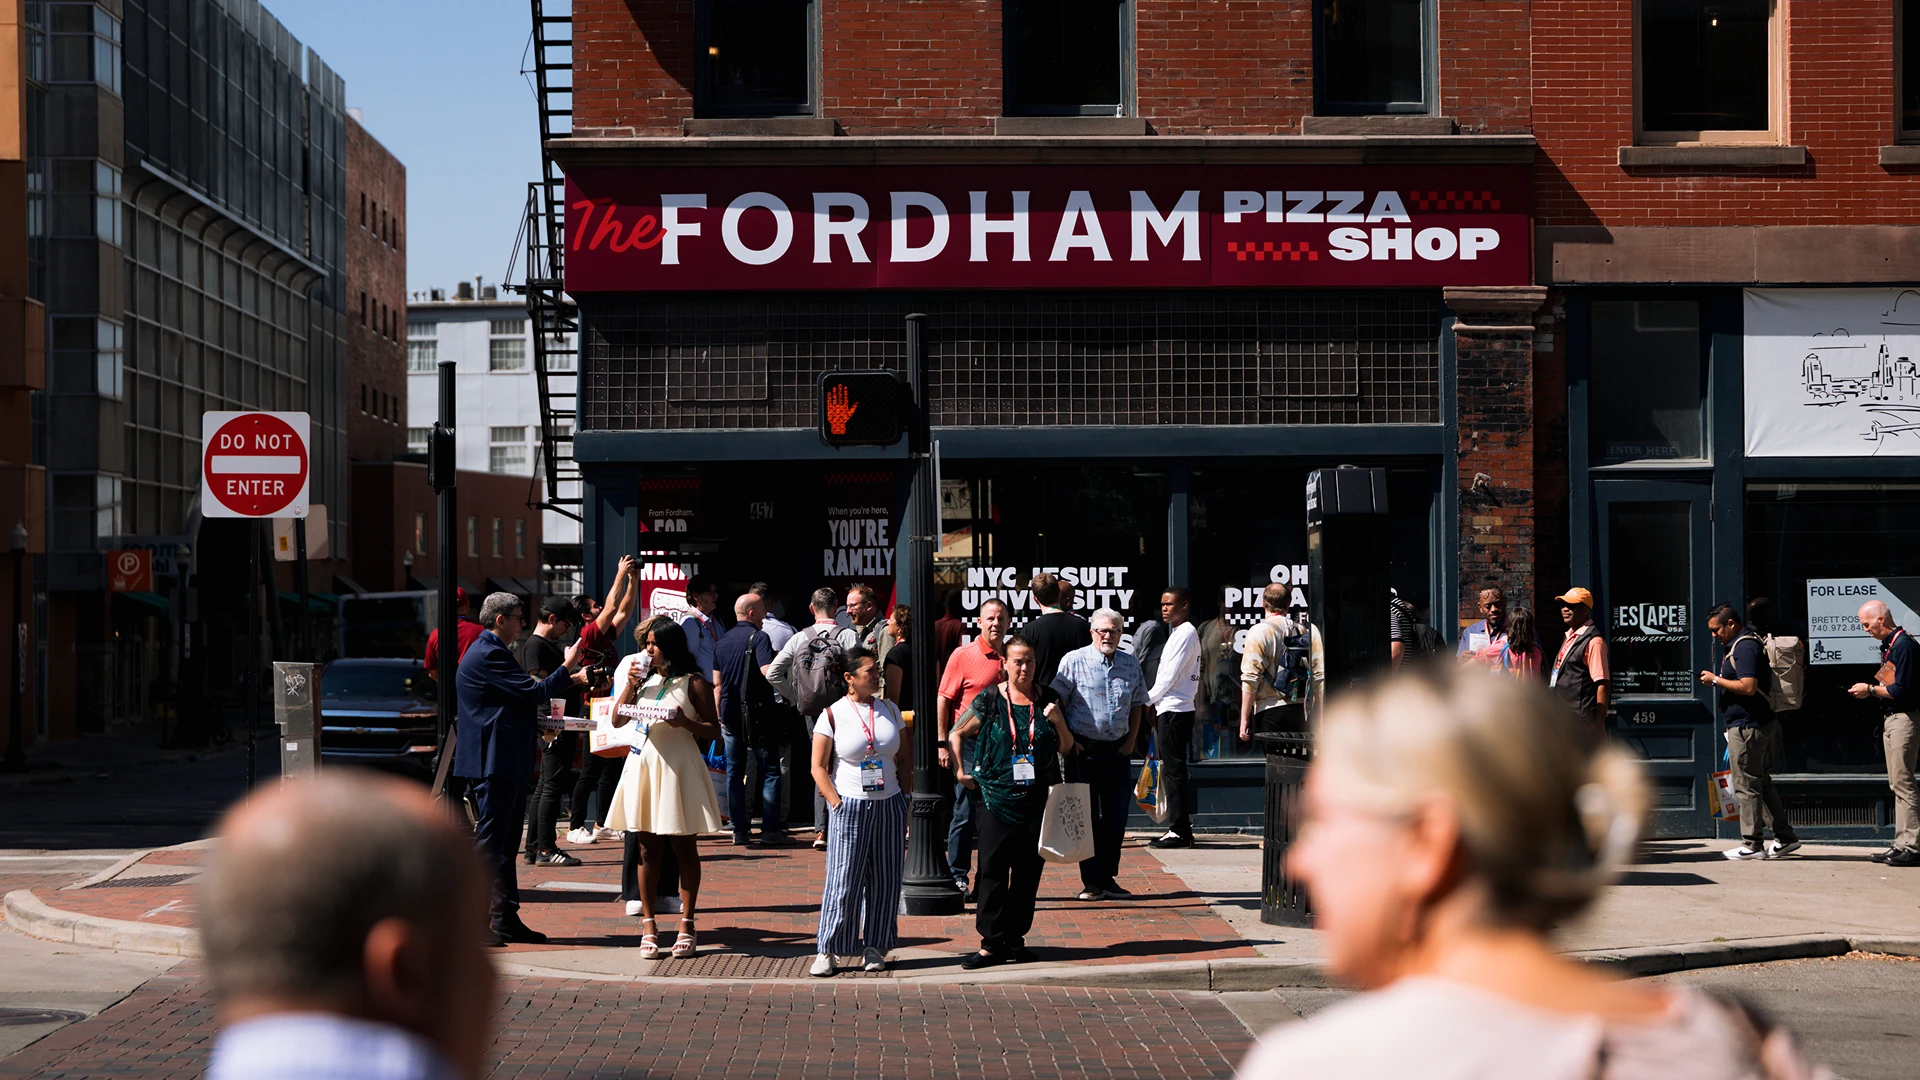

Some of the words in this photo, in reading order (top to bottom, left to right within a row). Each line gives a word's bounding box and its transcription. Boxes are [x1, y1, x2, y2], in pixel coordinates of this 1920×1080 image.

[572, 197, 668, 253] The
[660, 190, 1202, 265] FORDHAM
[1223, 190, 1412, 223] PIZZA
[1328, 227, 1500, 260] SHOP
[220, 434, 245, 450] DO
[255, 434, 293, 450] NOT
[1610, 445, 1642, 455] ENTER
[1645, 446, 1677, 456] HERE
[227, 480, 285, 496] ENTER
[648, 508, 664, 518] From
[665, 508, 695, 519] Fordham,
[751, 502, 773, 521] 457
[828, 506, 848, 516] When
[849, 506, 870, 517] you're
[871, 506, 889, 516] here,
[828, 518, 889, 547] YOU'RE
[823, 548, 895, 576] RAMILY
[967, 566, 1017, 588] NYC
[1225, 587, 1309, 608] PIZA
[1811, 586, 1835, 597] FOR
[1837, 585, 1877, 596] LEASE
[961, 589, 1134, 610] UNIVSITY
[1678, 605, 1687, 626] ROOM
[1811, 616, 1839, 624] BRETT
[1841, 615, 1860, 623] POS
[1811, 623, 1865, 632] 740.972.84
[1630, 635, 1648, 643] YOU
[1648, 635, 1665, 643] GET
[1665, 635, 1689, 643] OUT?
[1633, 711, 1656, 724] 459
